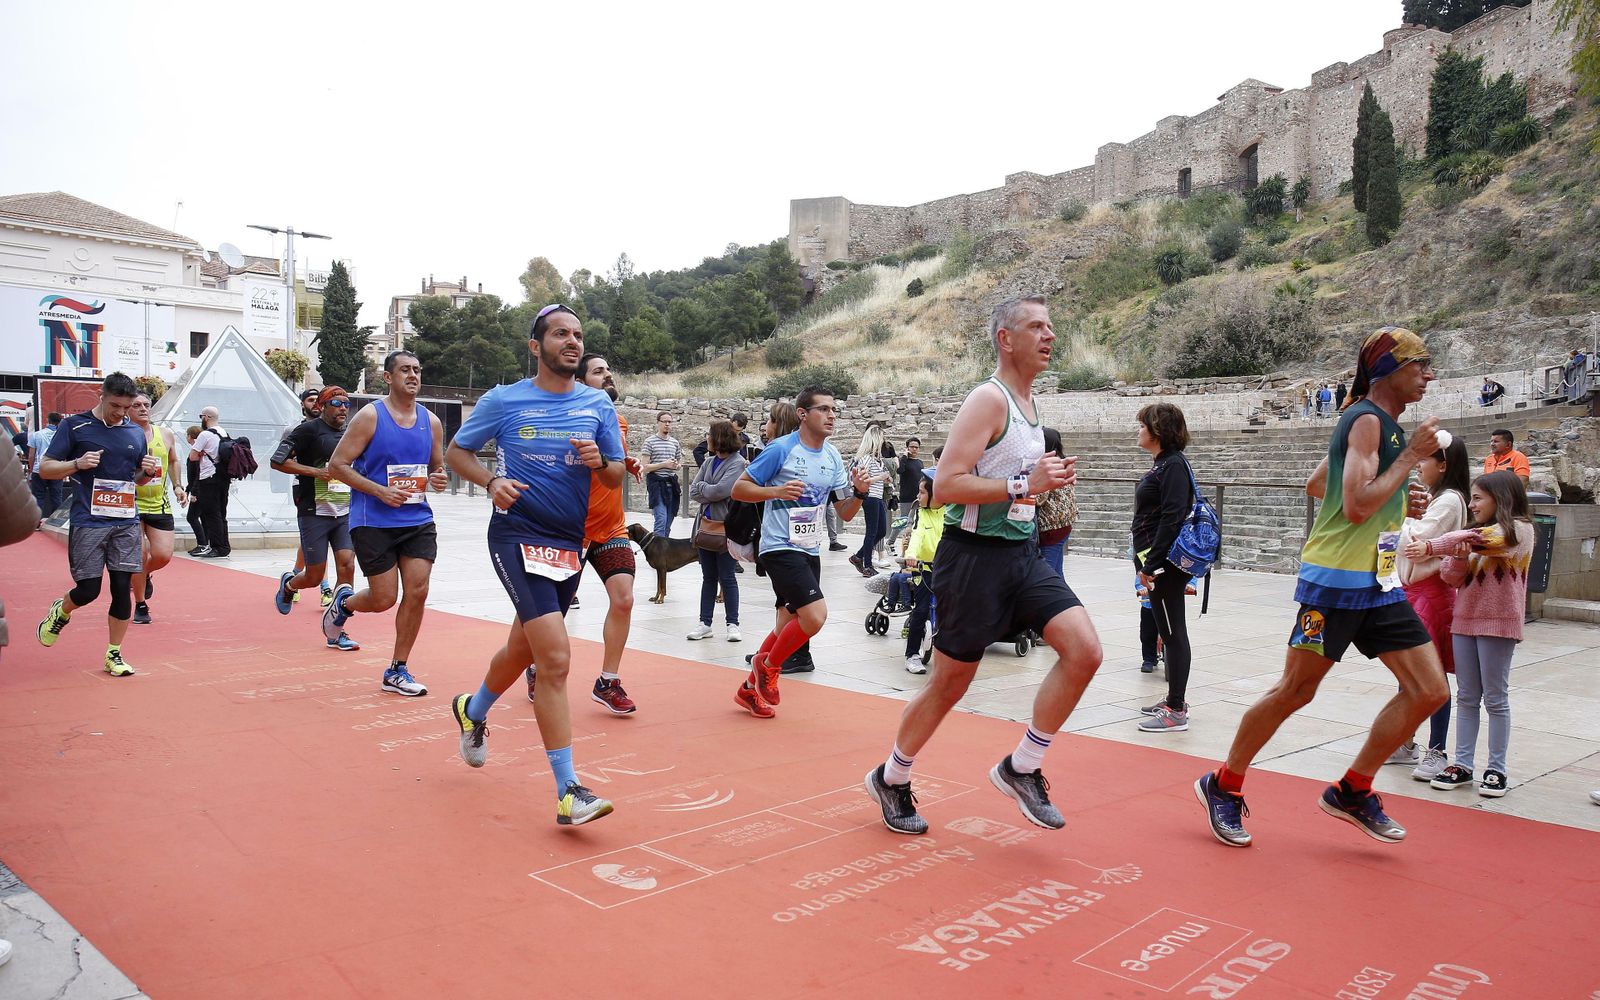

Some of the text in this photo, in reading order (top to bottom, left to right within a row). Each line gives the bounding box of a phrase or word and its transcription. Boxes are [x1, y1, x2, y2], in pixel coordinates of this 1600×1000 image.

[308, 273, 327, 283] Bilb
[252, 287, 268, 300] 22
[39, 311, 81, 320] ATRESMEDIA
[97, 493, 123, 504] 4821
[794, 523, 816, 534] 9373
[527, 545, 560, 560] 3167
[790, 837, 937, 890] de Málaga
[772, 845, 975, 922] Ayuntamiento
[938, 890, 1105, 971] FESTIVAL DE
[1185, 938, 1292, 1000] SUR
